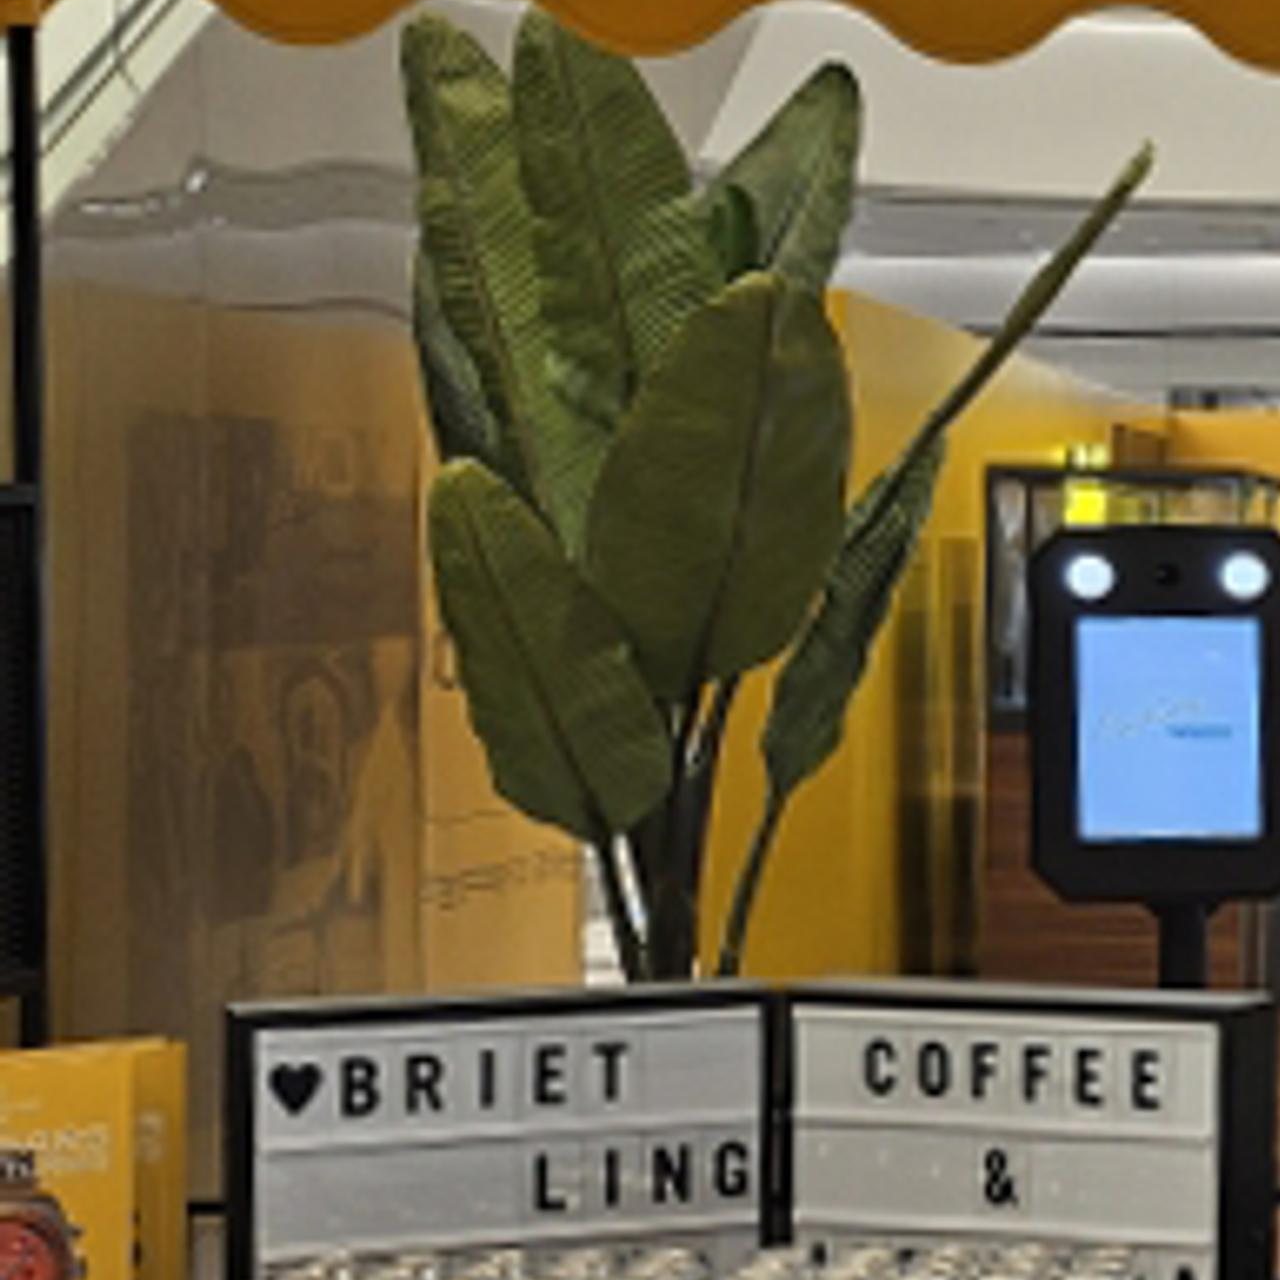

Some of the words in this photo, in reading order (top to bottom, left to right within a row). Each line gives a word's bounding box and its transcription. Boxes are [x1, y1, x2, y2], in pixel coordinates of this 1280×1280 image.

[341, 1043, 627, 1117] BRIET
[865, 1038, 1160, 1110] COFFEE
[534, 1141, 747, 1210] LING
[984, 1148, 1018, 1206] &
